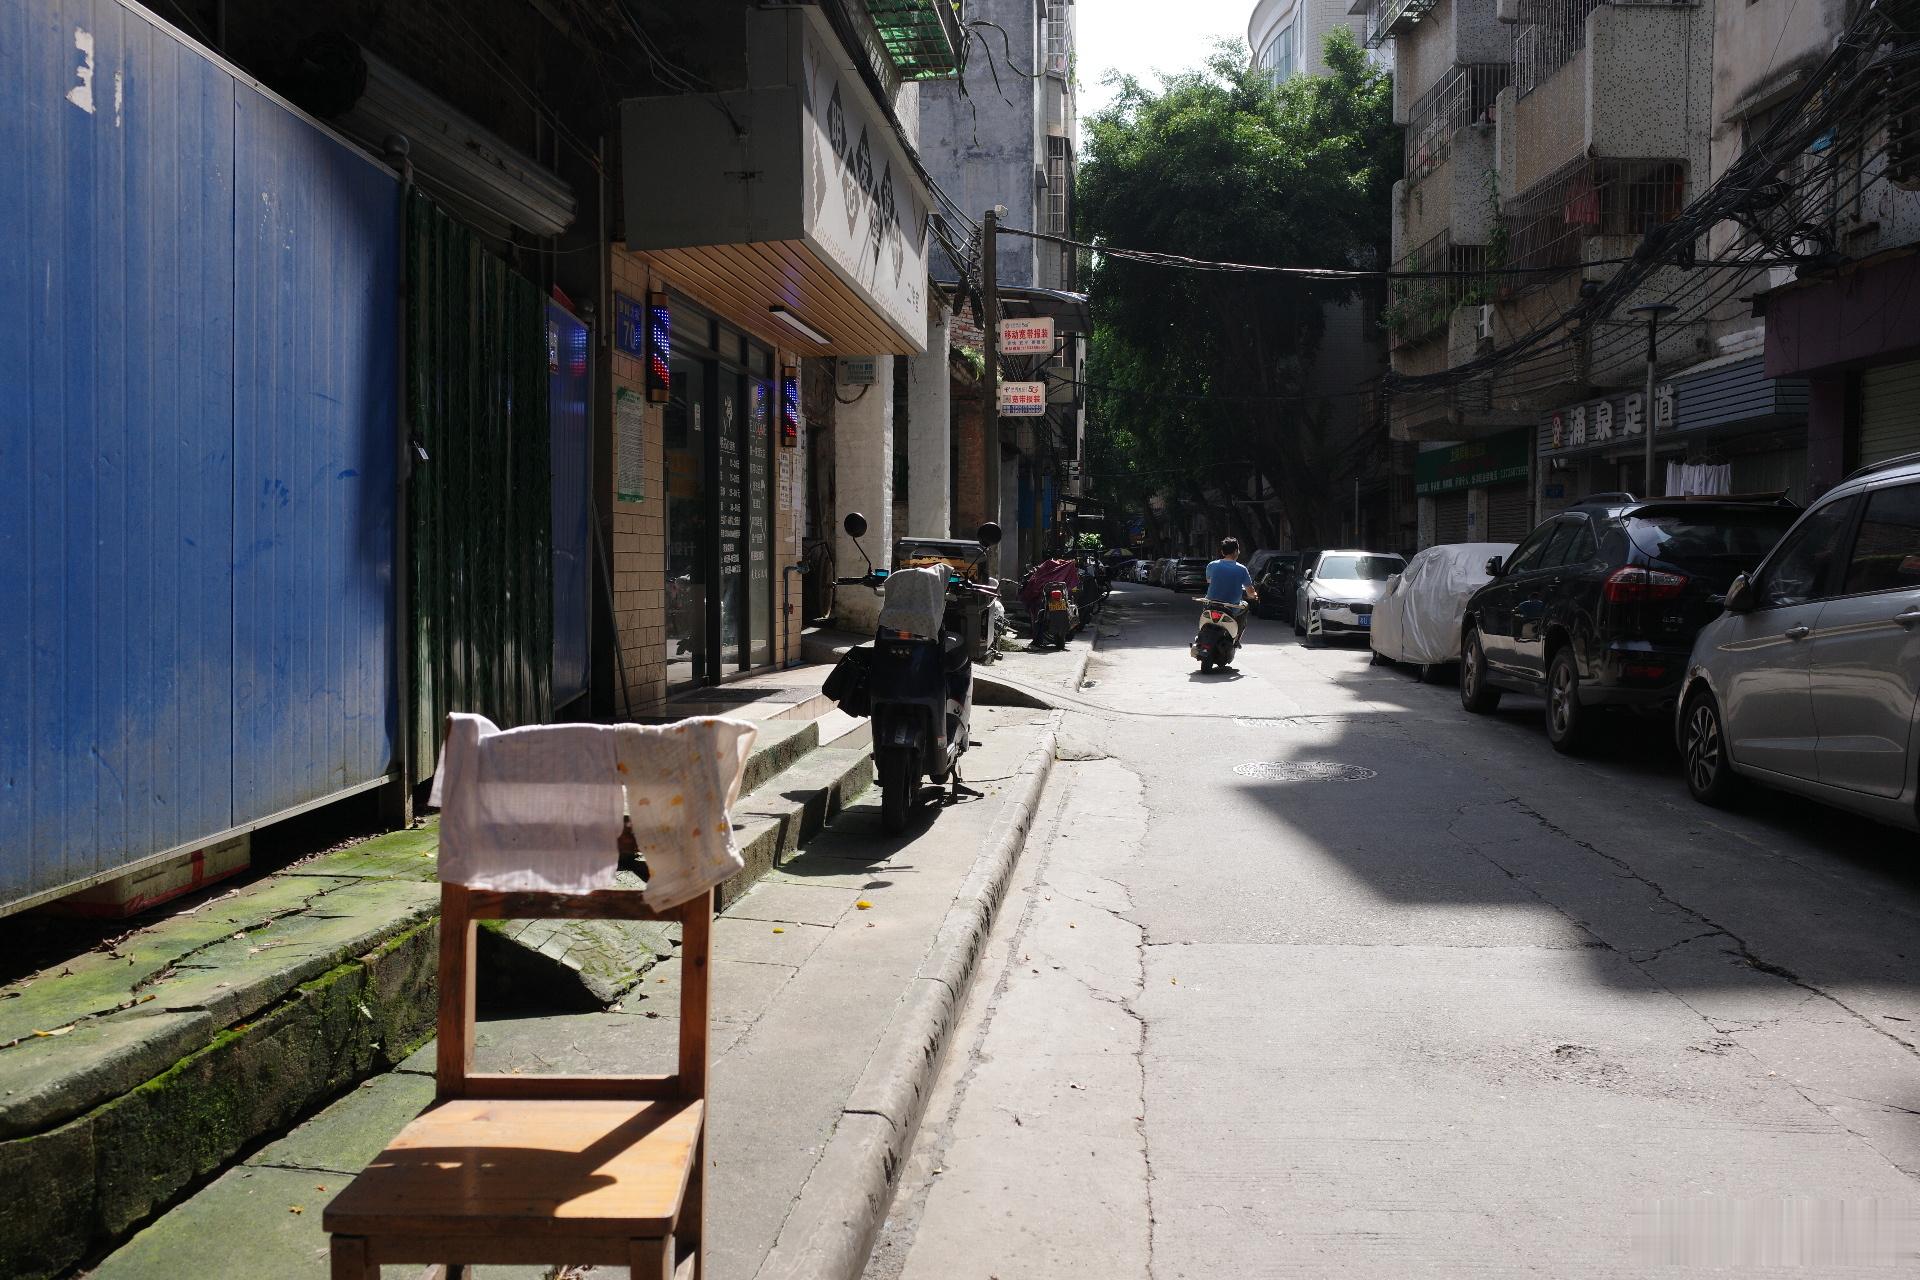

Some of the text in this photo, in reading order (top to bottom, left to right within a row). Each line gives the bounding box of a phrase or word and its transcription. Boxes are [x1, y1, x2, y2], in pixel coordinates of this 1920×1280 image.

[1004, 328, 1048, 340] 移动宽带报装
[1028, 385, 1039, 393] 5G
[1569, 384, 1674, 446] 涌泉足道
